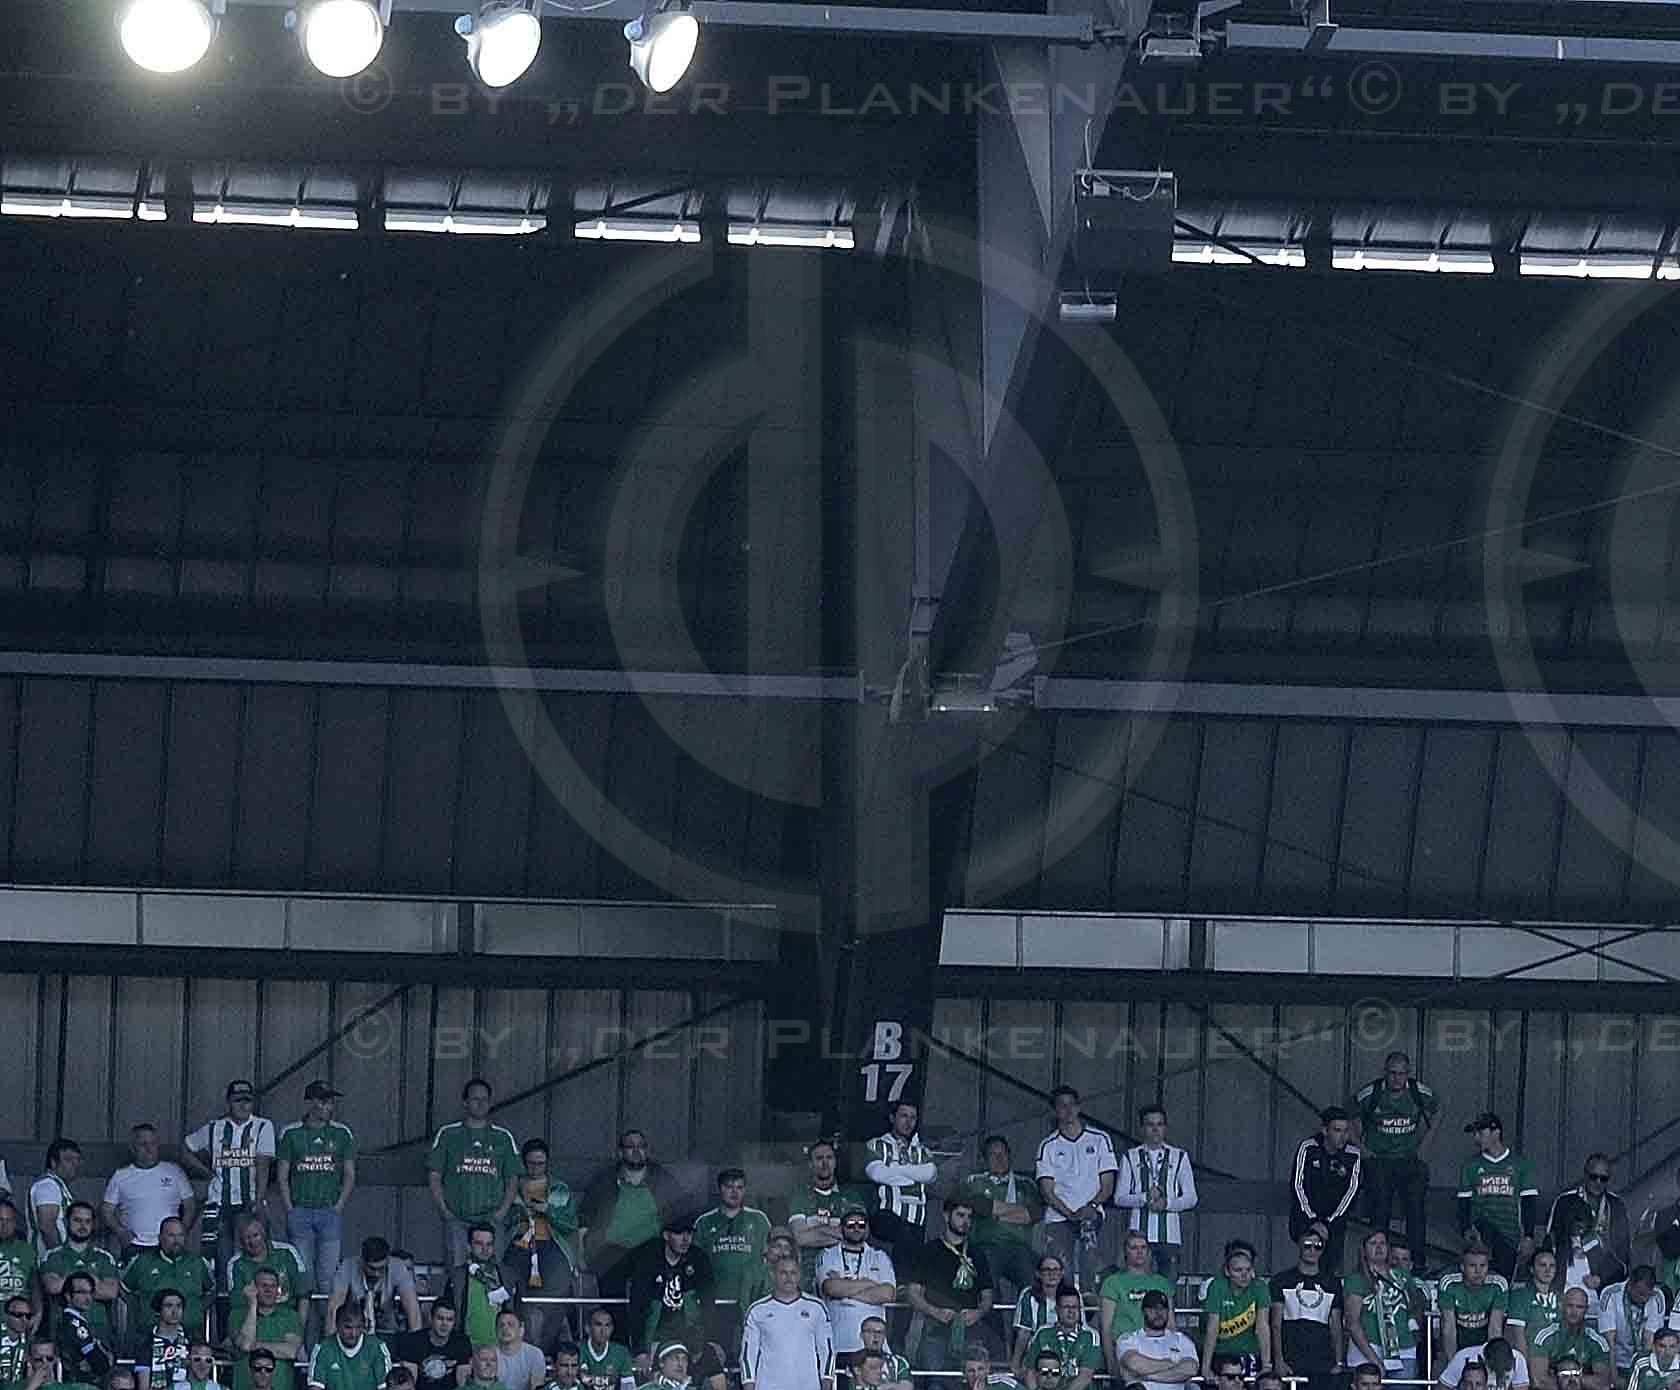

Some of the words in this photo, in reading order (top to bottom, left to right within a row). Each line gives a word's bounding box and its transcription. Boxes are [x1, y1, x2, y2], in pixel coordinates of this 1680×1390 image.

[873, 1022, 903, 1060] B
[863, 1064, 914, 1102] 17
[1482, 1177, 1508, 1185] WIEN
